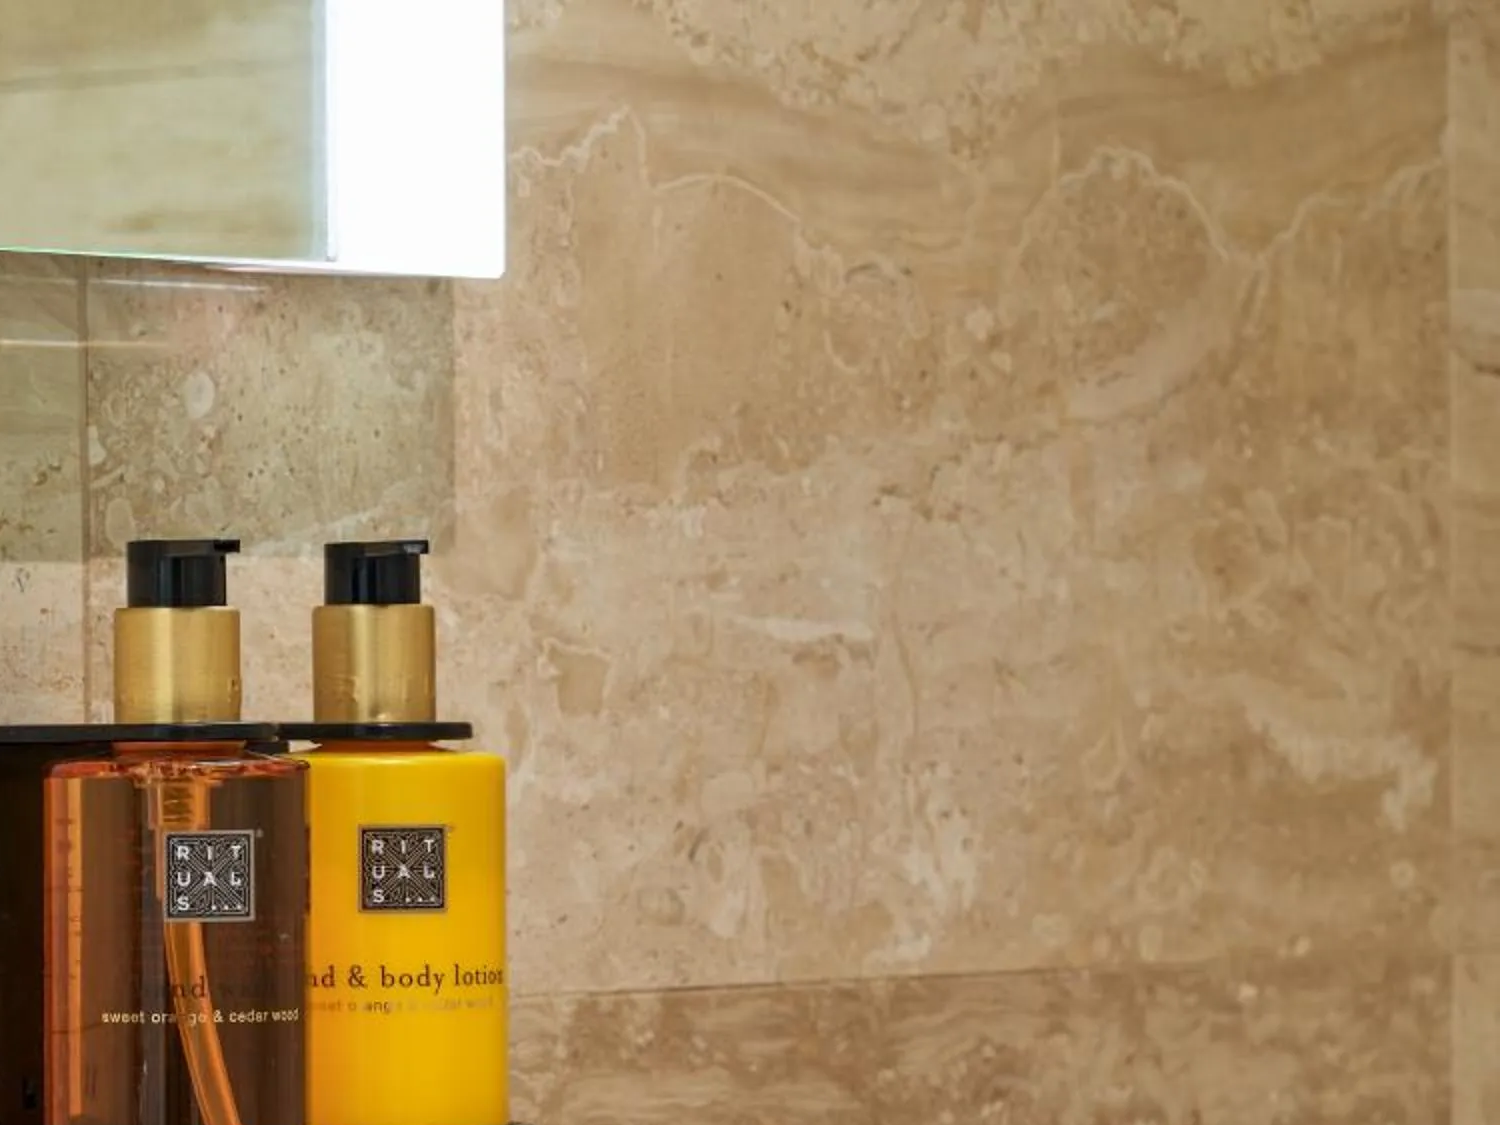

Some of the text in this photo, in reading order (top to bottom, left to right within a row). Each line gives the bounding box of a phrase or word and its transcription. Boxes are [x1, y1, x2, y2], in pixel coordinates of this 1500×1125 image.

[306, 964, 336, 988] nd
[347, 964, 367, 988] &
[379, 964, 446, 996] body
[101, 1007, 300, 1027] sweet orage & cedar wood
